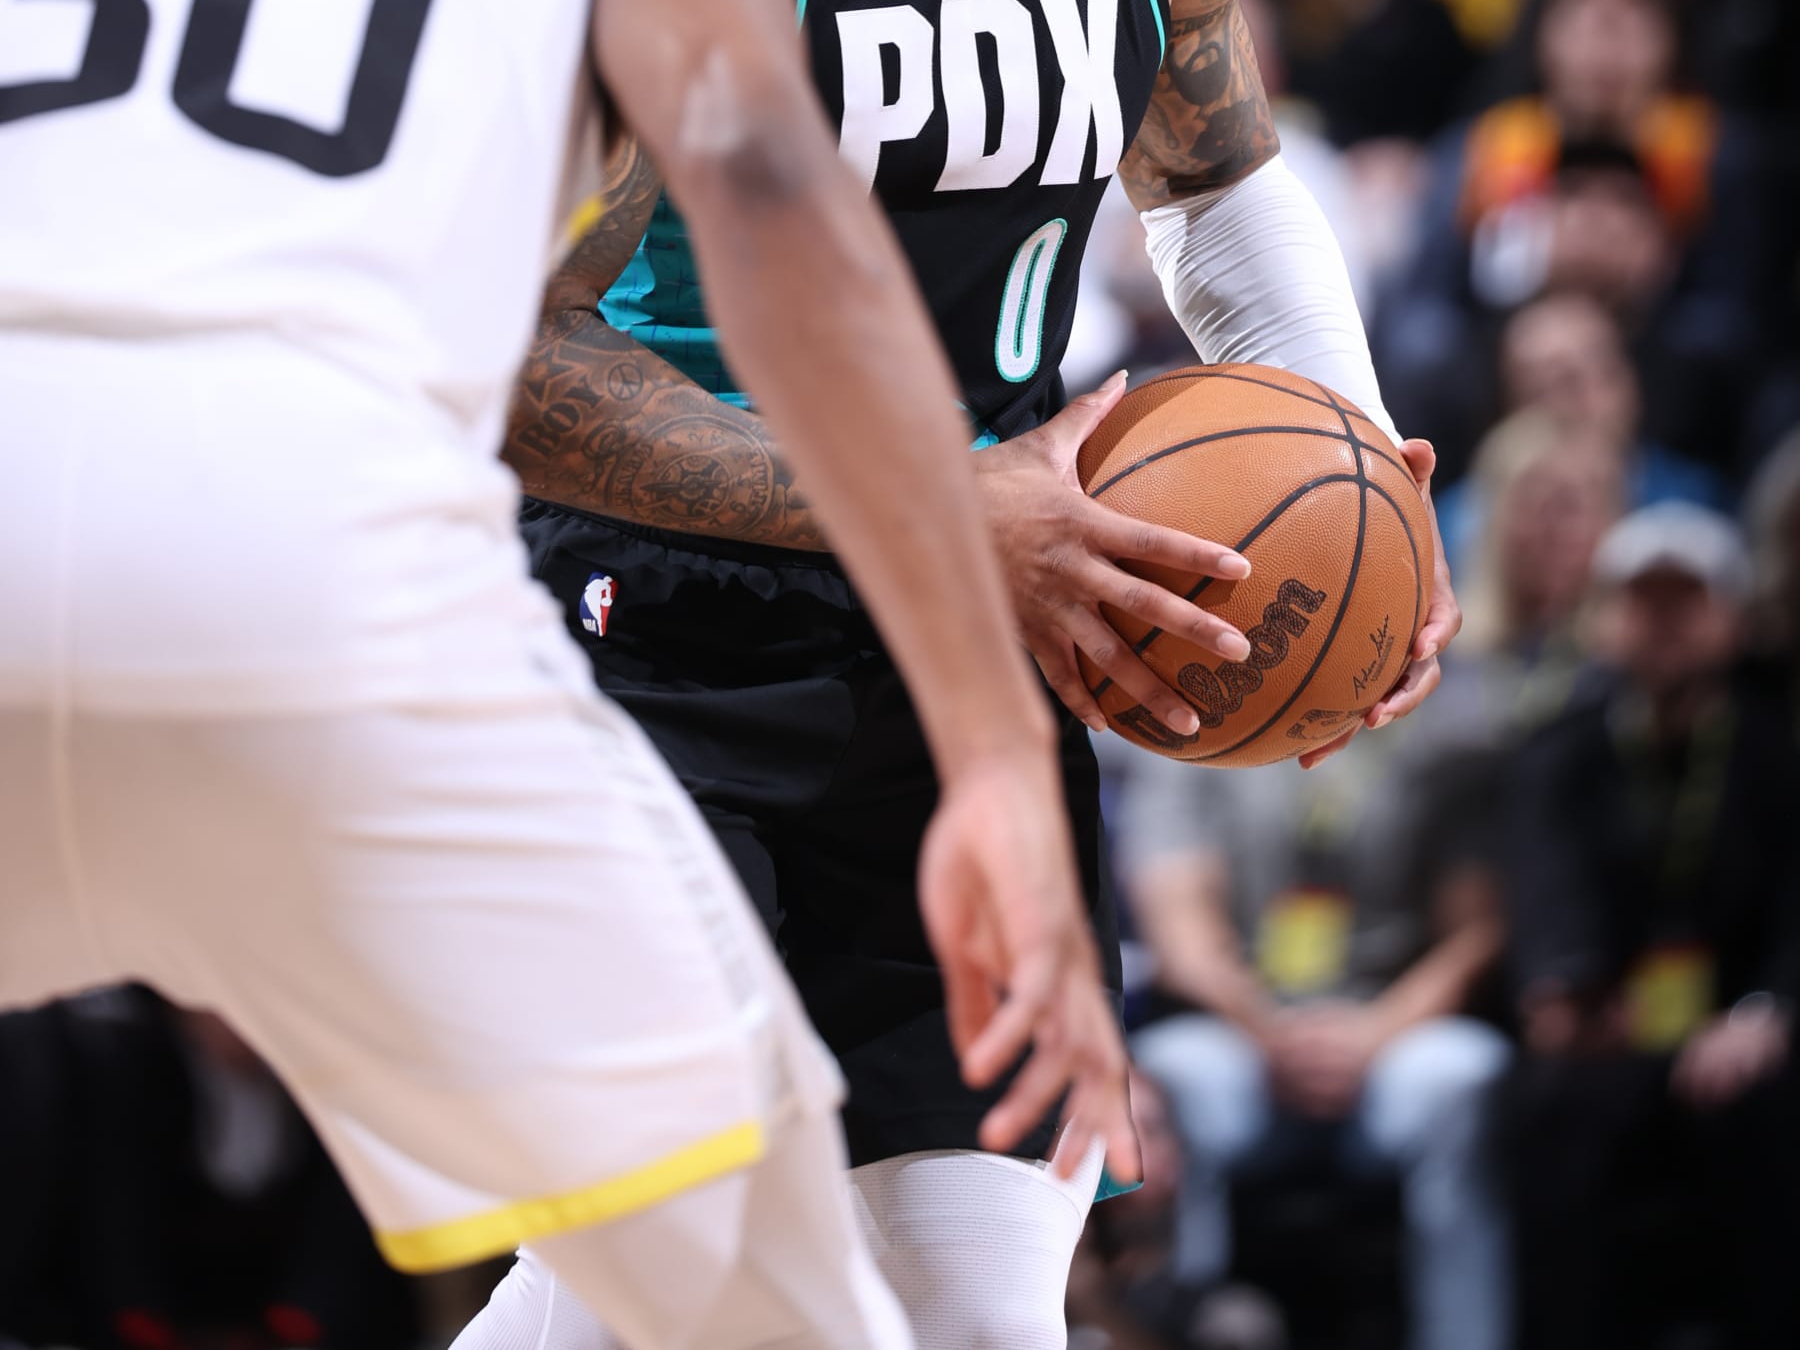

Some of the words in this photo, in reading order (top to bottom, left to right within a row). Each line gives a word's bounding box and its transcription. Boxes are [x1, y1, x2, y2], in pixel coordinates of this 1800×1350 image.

[994, 217, 1068, 383] 0
[516, 373, 606, 458] BOY
[582, 617, 598, 632] NBA
